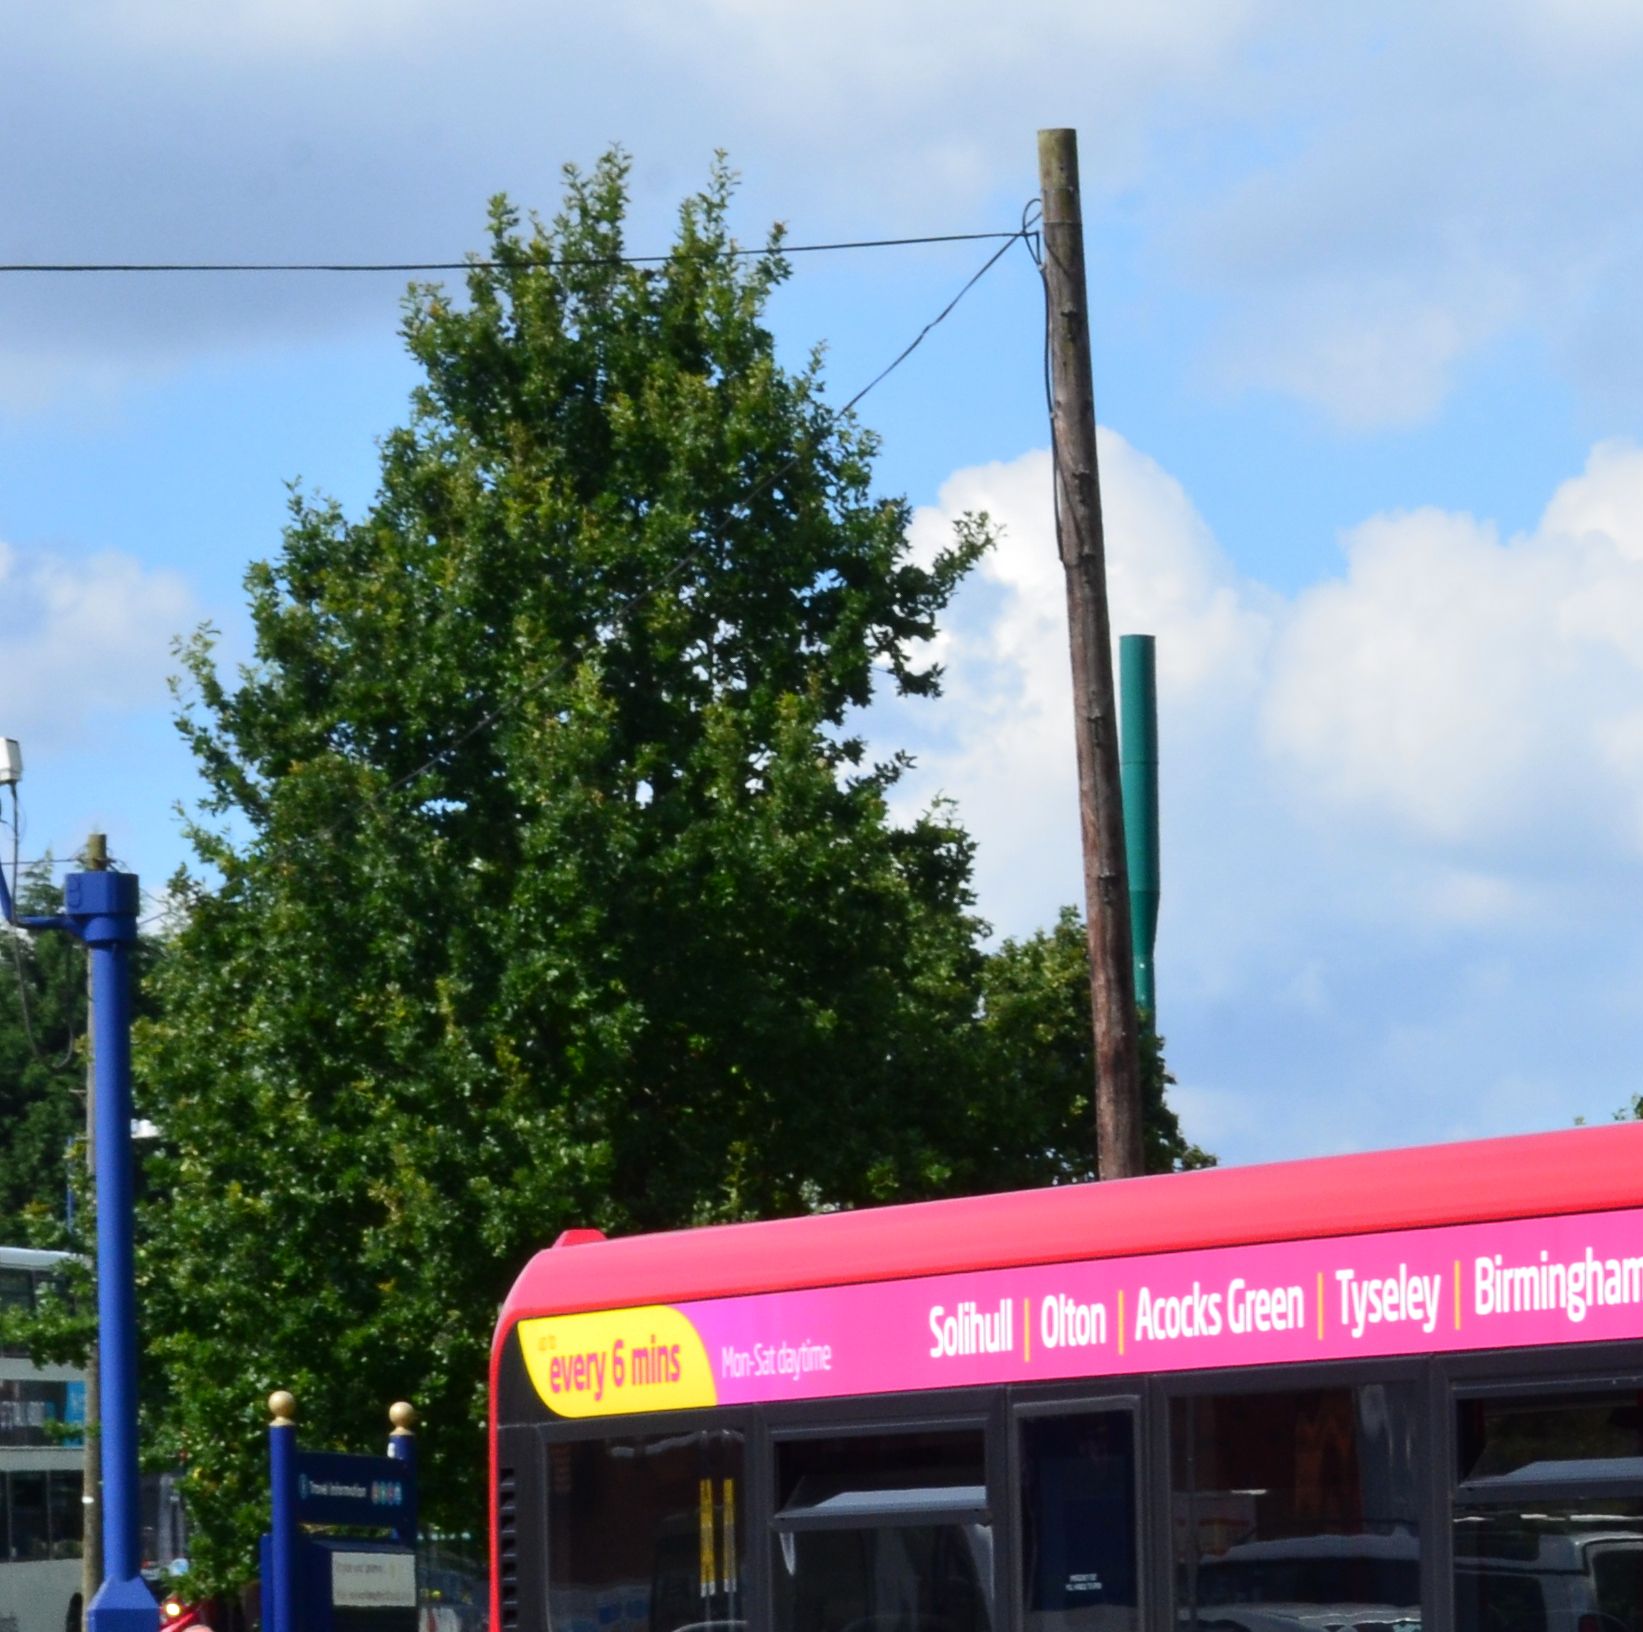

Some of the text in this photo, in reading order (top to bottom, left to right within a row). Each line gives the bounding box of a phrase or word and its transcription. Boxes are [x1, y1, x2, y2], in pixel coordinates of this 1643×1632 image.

[930, 1298, 1013, 1358] Solihull
[1041, 1293, 1107, 1349] Olton
[1134, 1278, 1305, 1341] Acocks Green
[1335, 1263, 1441, 1339] Tyseley
[550, 1334, 681, 1402] every 6 mins
[721, 1338, 832, 1381] Mon-Sat daytime
